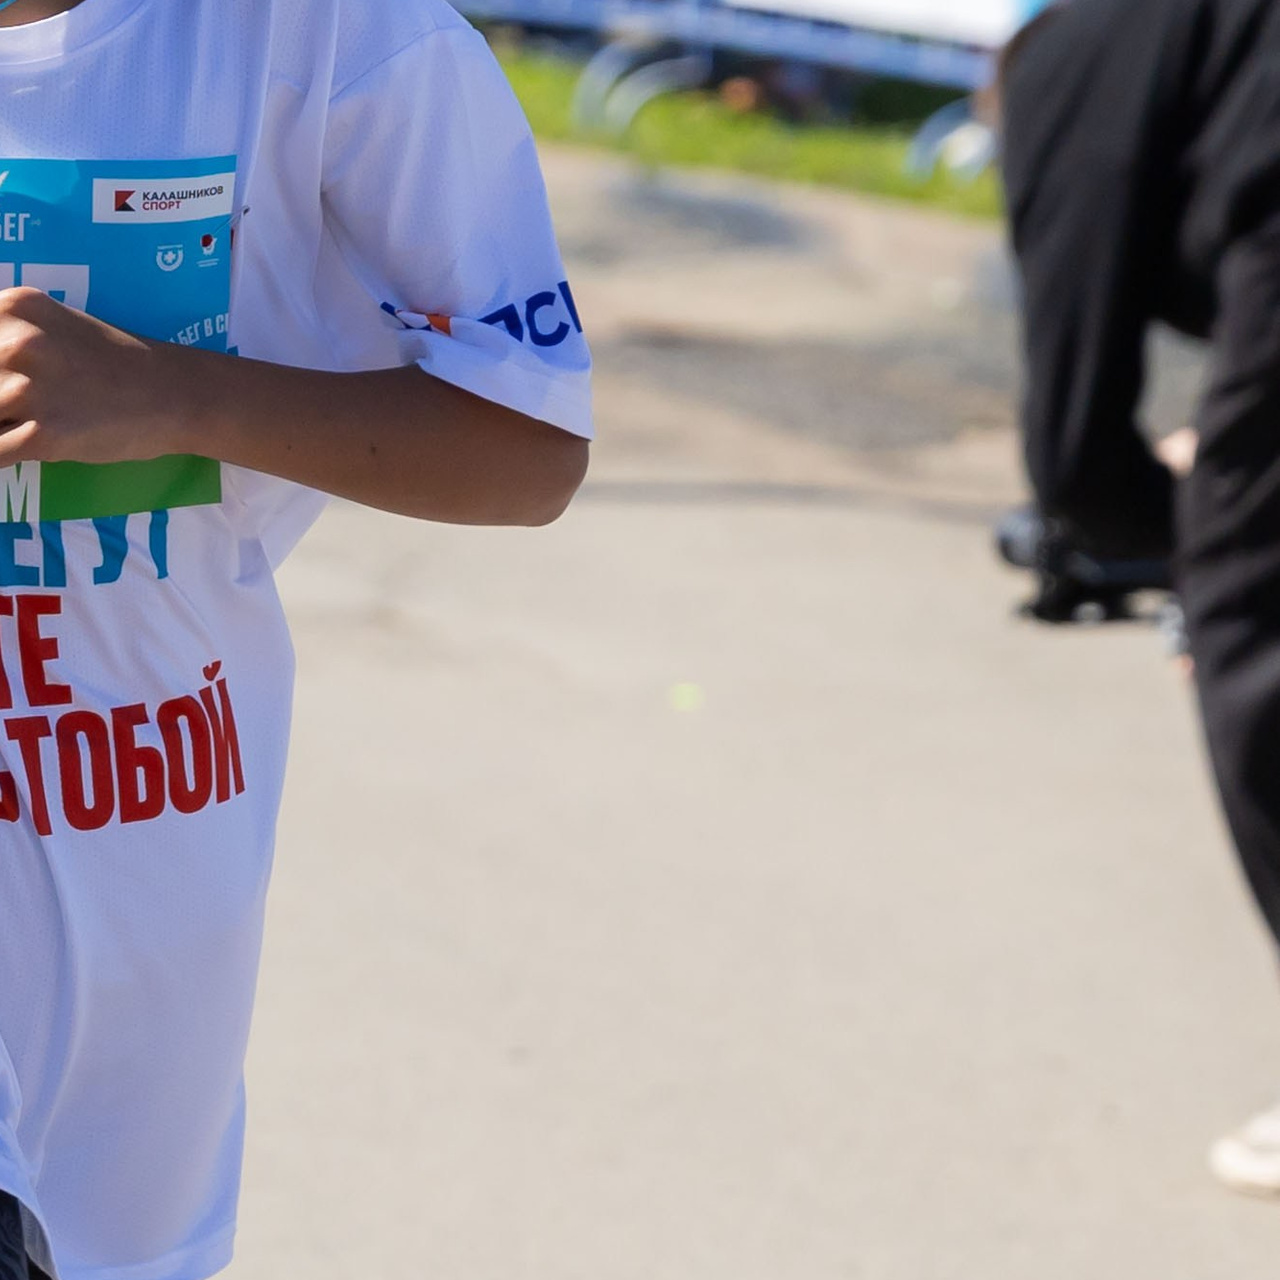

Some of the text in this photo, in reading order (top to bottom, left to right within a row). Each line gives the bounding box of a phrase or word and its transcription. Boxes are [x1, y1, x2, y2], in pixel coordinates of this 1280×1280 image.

[142, 185, 224, 201] КАЛАШНИКОВ
[142, 200, 181, 211] СПОРТ
[204, 318, 213, 337] В
